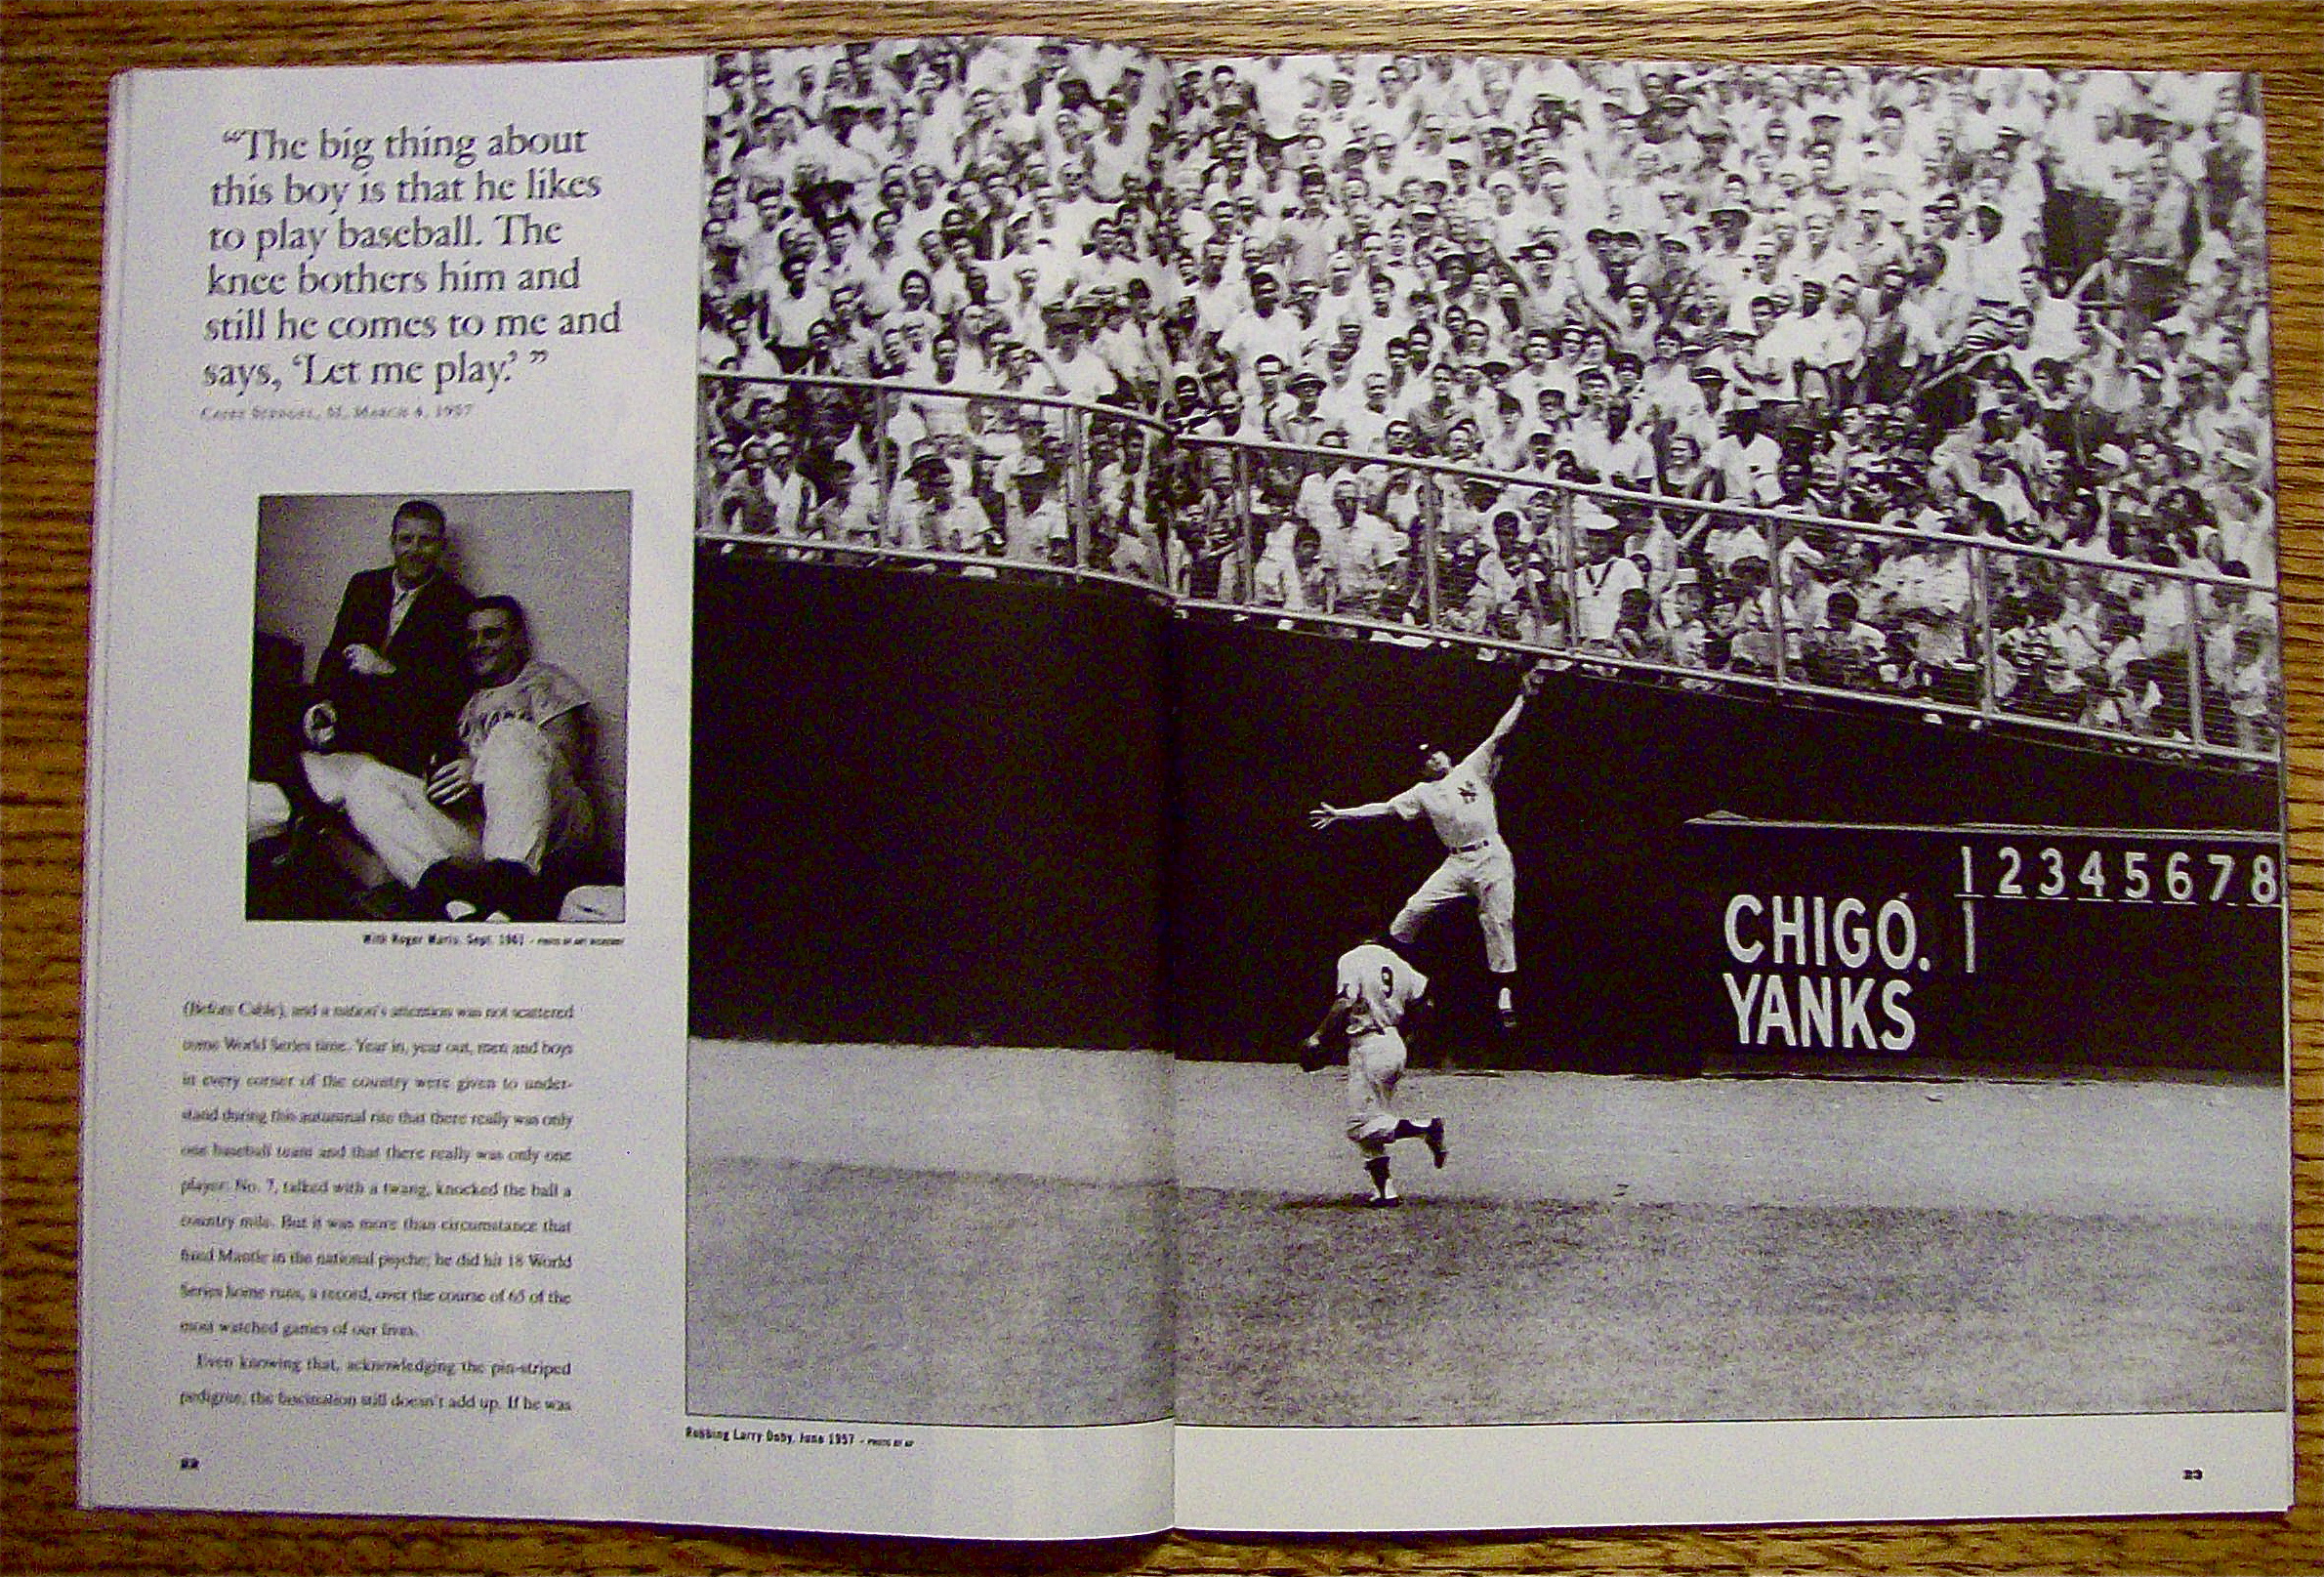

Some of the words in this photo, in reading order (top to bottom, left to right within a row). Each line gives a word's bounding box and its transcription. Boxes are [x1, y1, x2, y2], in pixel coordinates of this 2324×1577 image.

[320, 128, 375, 169] big
[386, 126, 477, 168] thing
[487, 123, 589, 156] about
[211, 174, 273, 207] this
[285, 173, 350, 214] boy
[359, 169, 386, 204] is
[396, 170, 465, 203] that
[476, 170, 517, 202] he
[527, 167, 602, 200] likes
[209, 228, 246, 251] to
[256, 218, 327, 260] play
[338, 215, 483, 249] baseball.
[494, 213, 563, 246] The
[206, 263, 287, 296] knee
[298, 261, 428, 294] bothers
[438, 257, 506, 292] him
[518, 257, 581, 291] and
[205, 308, 267, 342] still
[277, 308, 318, 341] he
[327, 316, 438, 340] comes
[448, 314, 486, 338] to
[495, 314, 549, 337] me
[559, 301, 622, 335] and
[203, 362, 282, 396] says,
[371, 361, 425, 385] me
[1961, 846, 1972, 892] 1
[1998, 847, 2023, 894] 2
[2039, 848, 2066, 896] 3
[2079, 851, 2105, 897] 4
[2125, 851, 2150, 899] 5
[2165, 851, 2194, 901] 6
[2207, 854, 2236, 901] 7
[2251, 855, 2278, 904] 8
[1724, 893, 1930, 973] CHIGO.
[1381, 966, 1393, 999] 9
[1722, 973, 1917, 1051] YANKS
[733, 1429, 763, 1443] Larry
